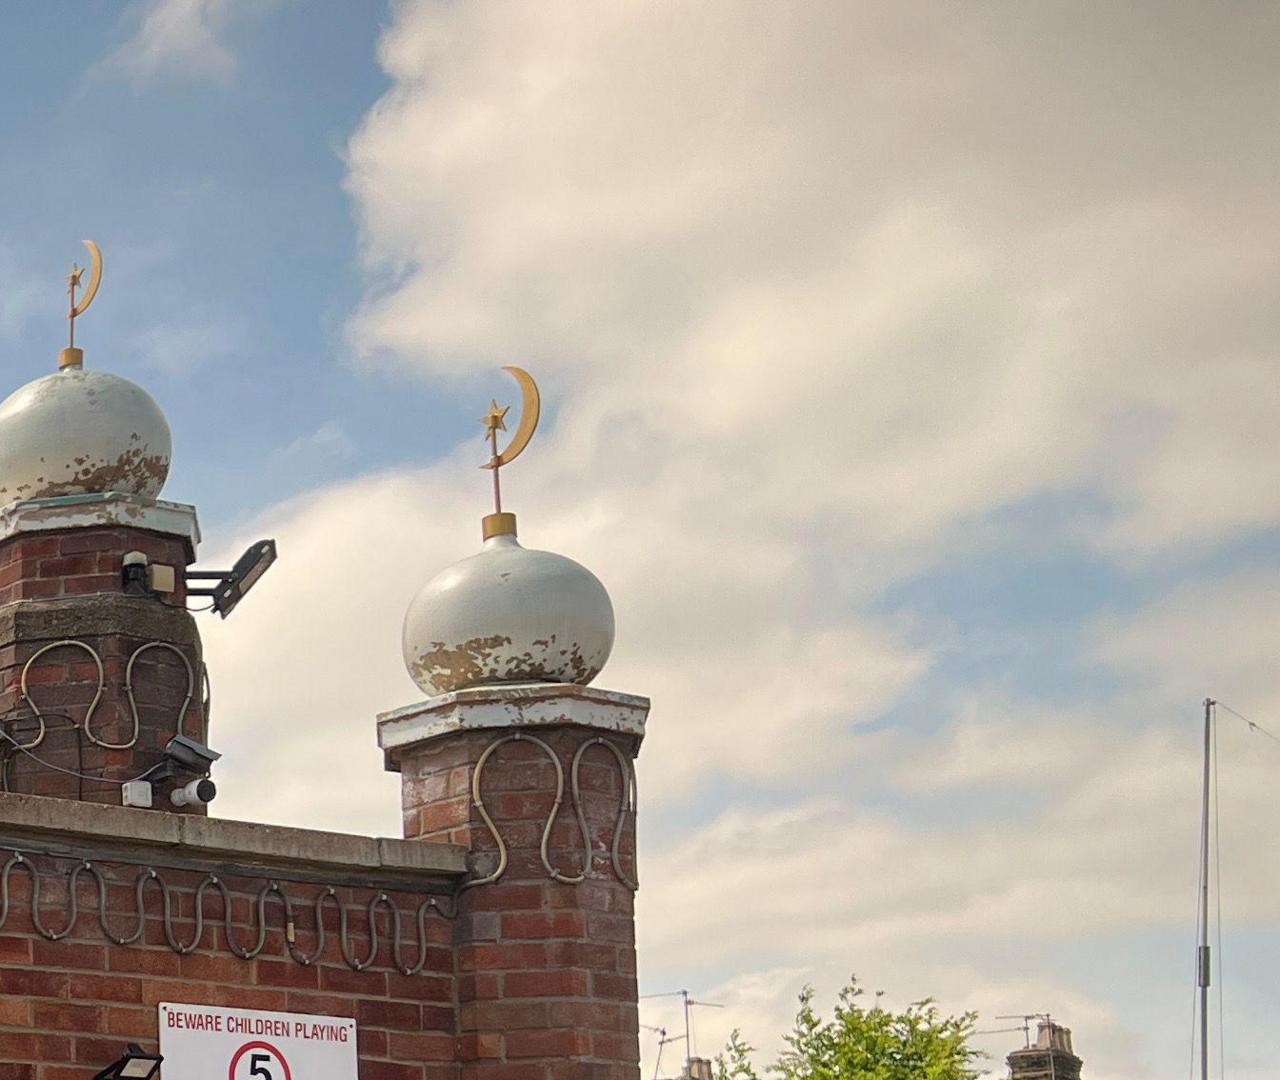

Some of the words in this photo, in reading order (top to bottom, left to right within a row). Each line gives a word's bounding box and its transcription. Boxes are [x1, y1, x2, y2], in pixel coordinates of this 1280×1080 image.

[167, 1011, 222, 1032] BEWARE
[227, 1016, 290, 1037] CHILDREN
[295, 1022, 347, 1042] PLAYING
